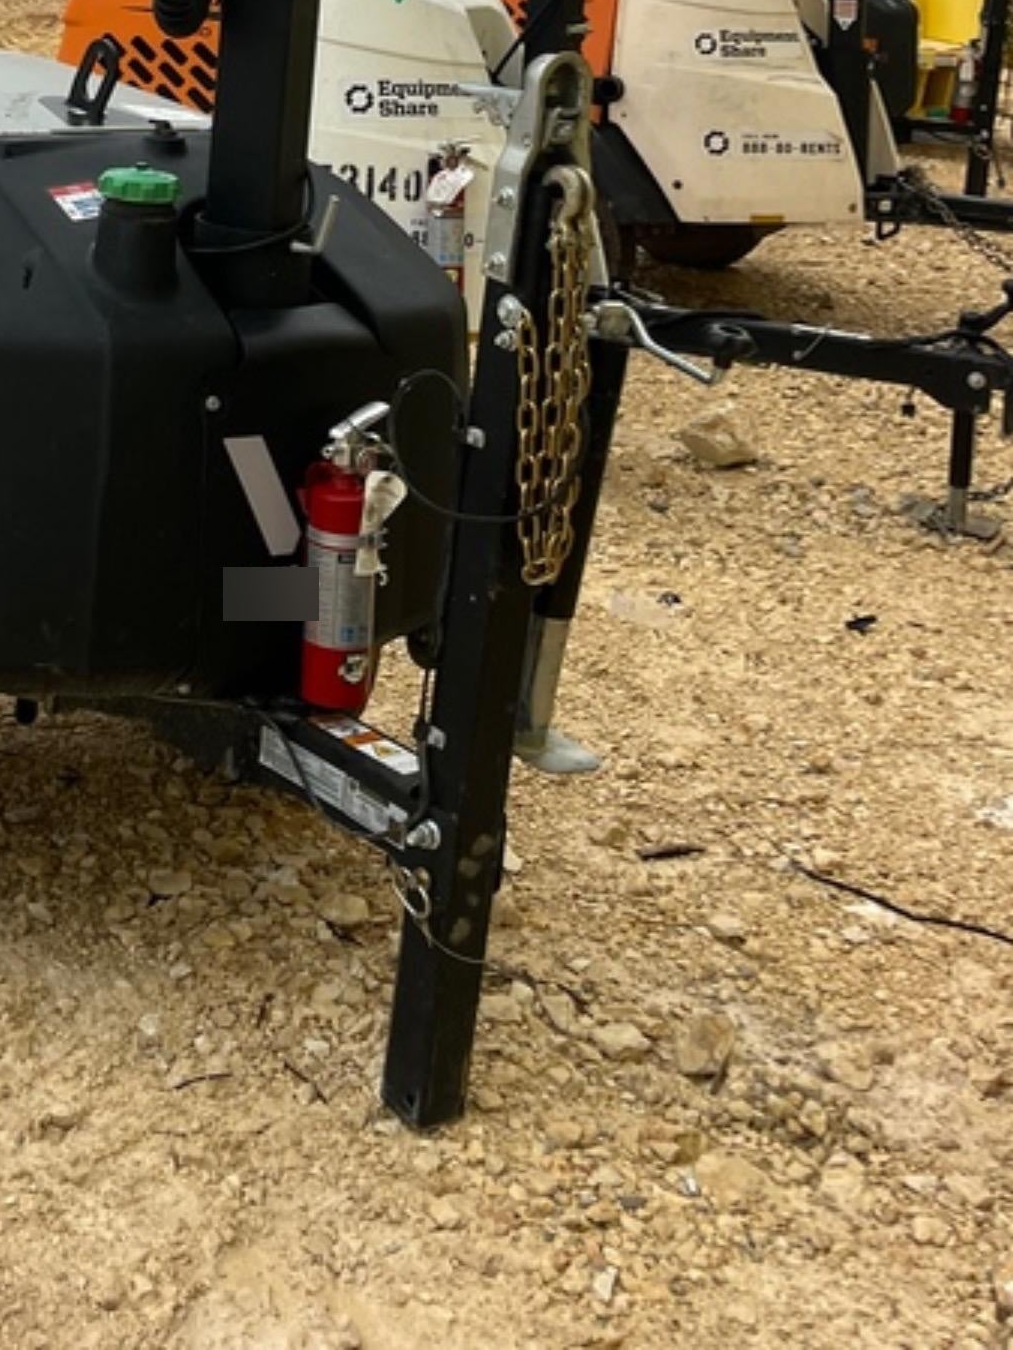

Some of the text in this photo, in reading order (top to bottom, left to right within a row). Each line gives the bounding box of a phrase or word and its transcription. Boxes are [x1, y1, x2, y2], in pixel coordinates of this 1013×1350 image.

[720, 45, 766, 58] Share
[377, 79, 461, 99] Equipme
[378, 100, 439, 117] Share
